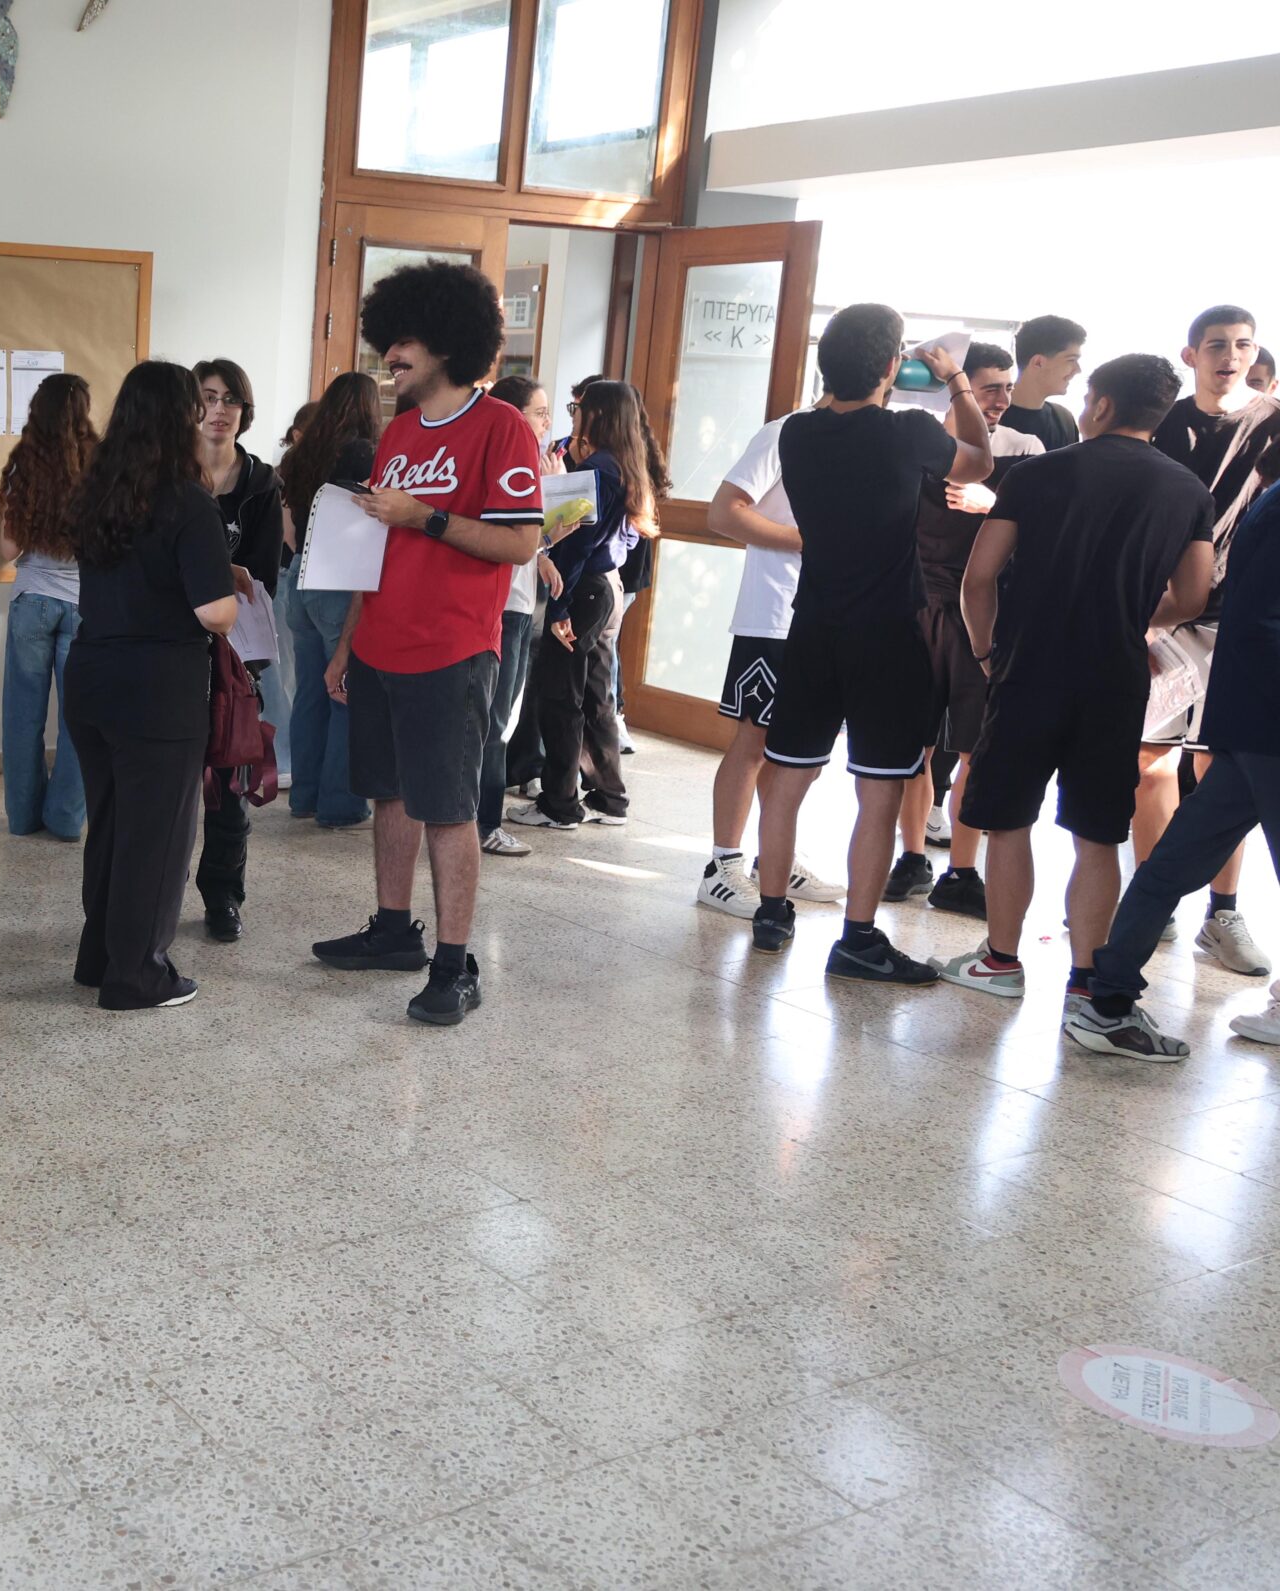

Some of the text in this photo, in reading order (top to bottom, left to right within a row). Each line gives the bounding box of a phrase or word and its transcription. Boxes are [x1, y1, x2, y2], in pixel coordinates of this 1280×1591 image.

[703, 300, 776, 323] ΠΤΕΡΥΓΑ
[375, 445, 459, 495] Reds
[498, 467, 537, 497] C
